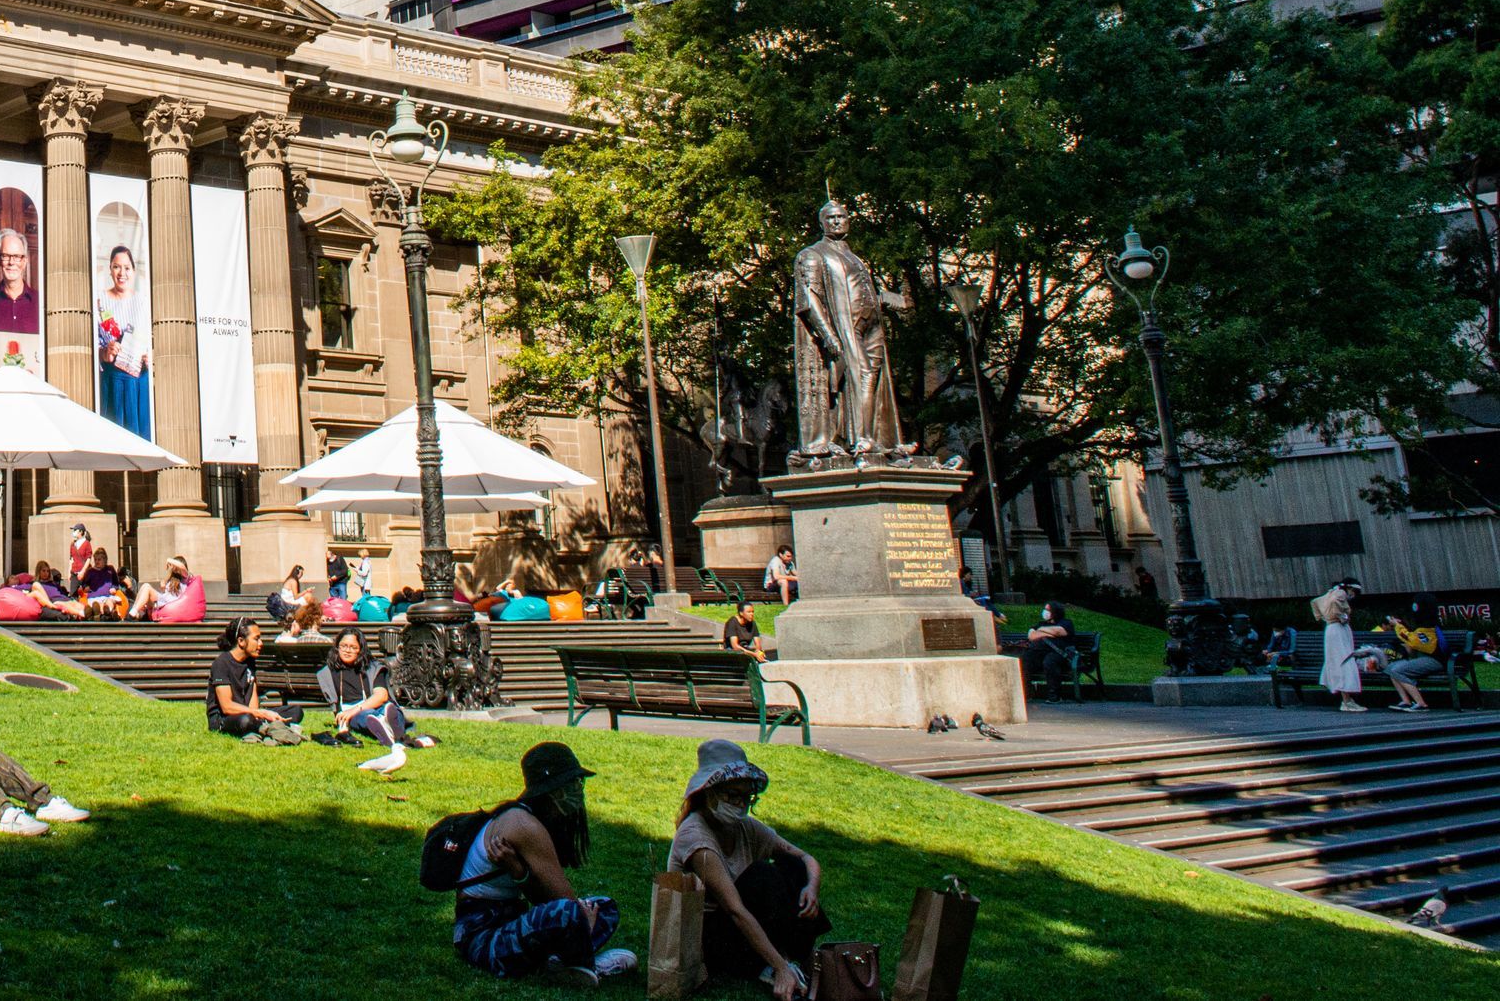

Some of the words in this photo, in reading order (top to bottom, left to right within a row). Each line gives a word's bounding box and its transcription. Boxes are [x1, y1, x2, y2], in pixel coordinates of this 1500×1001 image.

[199, 316, 216, 325] HERE
[218, 317, 231, 326] FOR
[212, 328, 239, 337] ALWAYS
